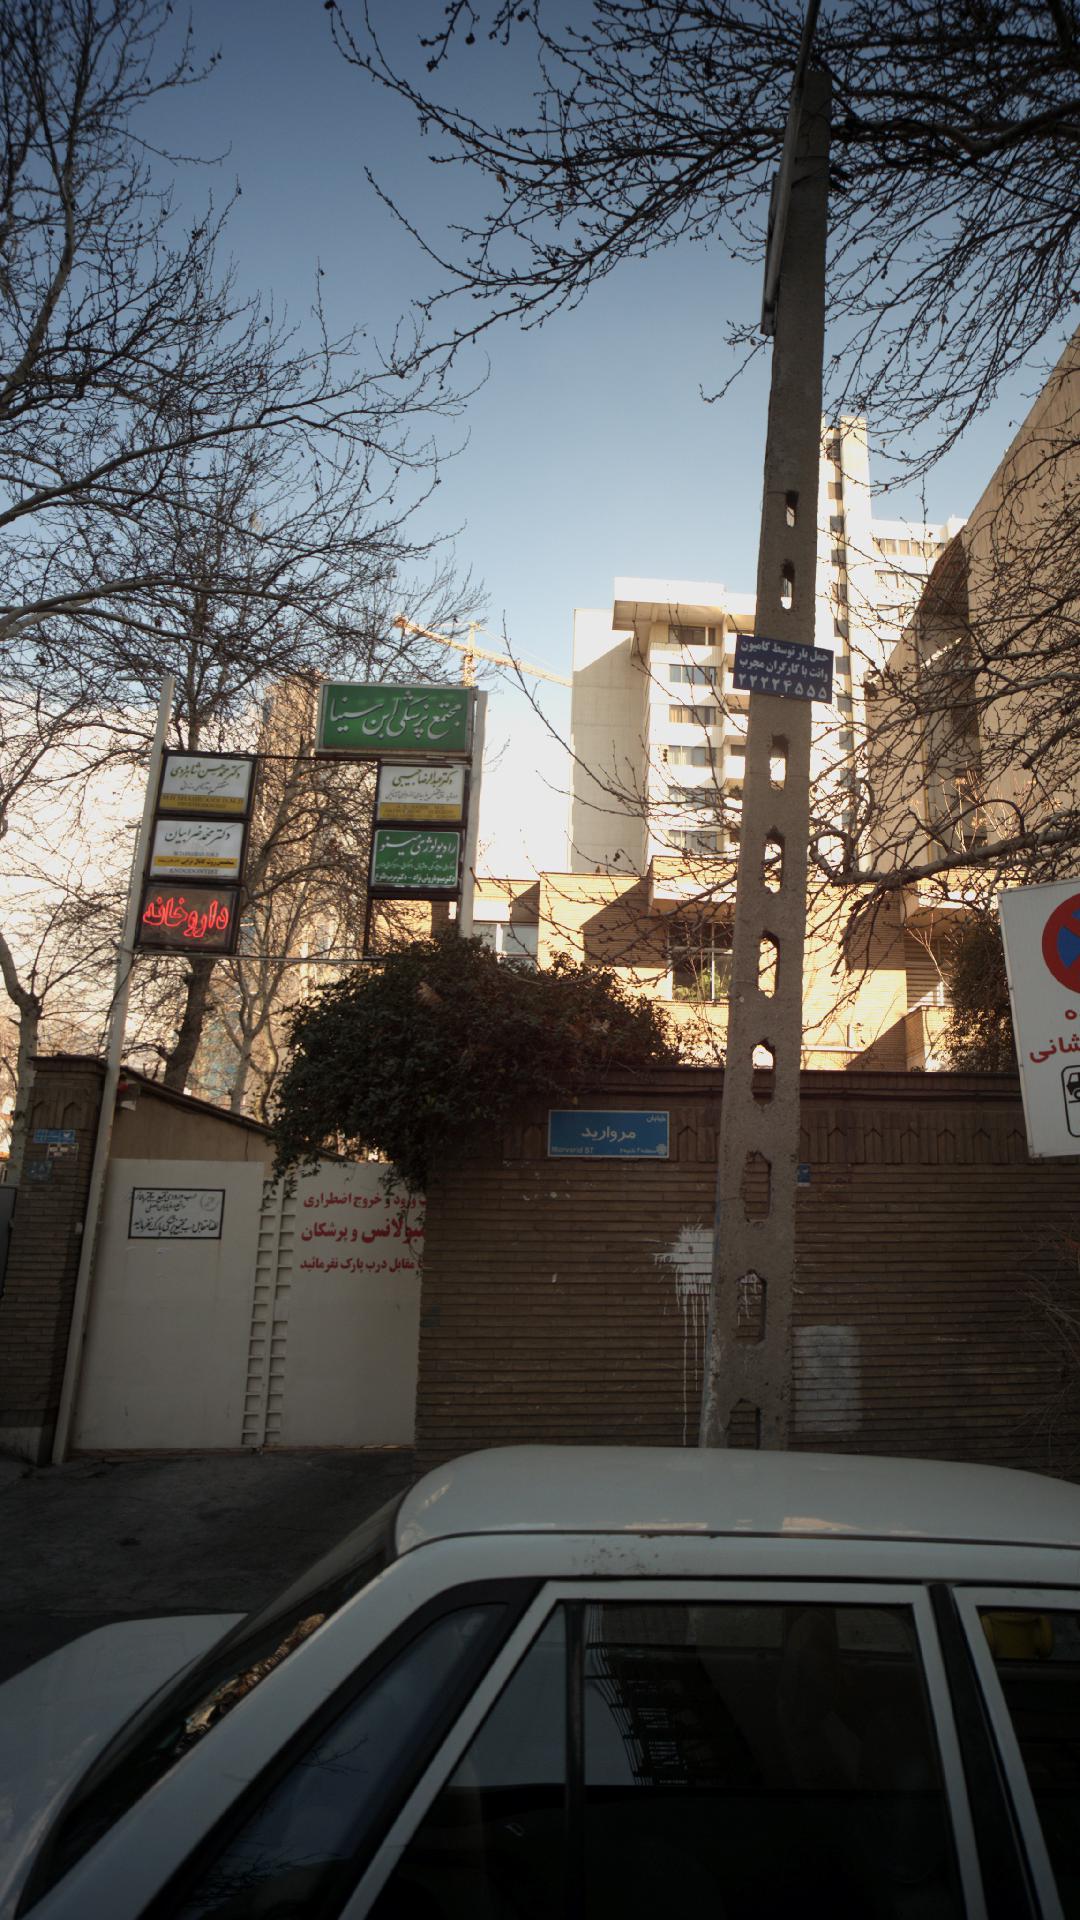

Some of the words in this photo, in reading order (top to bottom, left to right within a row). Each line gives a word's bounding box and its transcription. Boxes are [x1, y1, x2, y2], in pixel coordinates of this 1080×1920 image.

[740, 640, 770, 653] کامیون
[772, 642, 796, 657] توسط
[796, 648, 808, 660] بار
[739, 658, 764, 670] مجرب
[809, 651, 829, 662] حمل
[765, 660, 800, 675] کارگران
[809, 668, 828, 683] وانت
[330, 696, 384, 733] سینا
[361, 697, 399, 739] ابن
[386, 691, 430, 738] پزشکی
[428, 703, 462, 740] مجتمع
[225, 764, 245, 780] دکتر
[392, 768, 422, 788] حبیبی
[438, 769, 459, 787] دکتر
[199, 827, 214, 840] محمد
[206, 823, 238, 846] دکتر
[379, 834, 422, 856] مینو
[410, 836, 456, 859] رادیولوژی
[143, 896, 229, 938] داروخانه
[1029, 1033, 1080, 1063] شانی
[581, 1126, 637, 1142] مروارید
[303, 1192, 352, 1209] اضطراری
[353, 1192, 382, 1209] خروج
[350, 1229, 358, 1242] و
[340, 1257, 364, 1273] پارک
[366, 1259, 388, 1273] درب
[389, 1257, 415, 1273] مقابل
